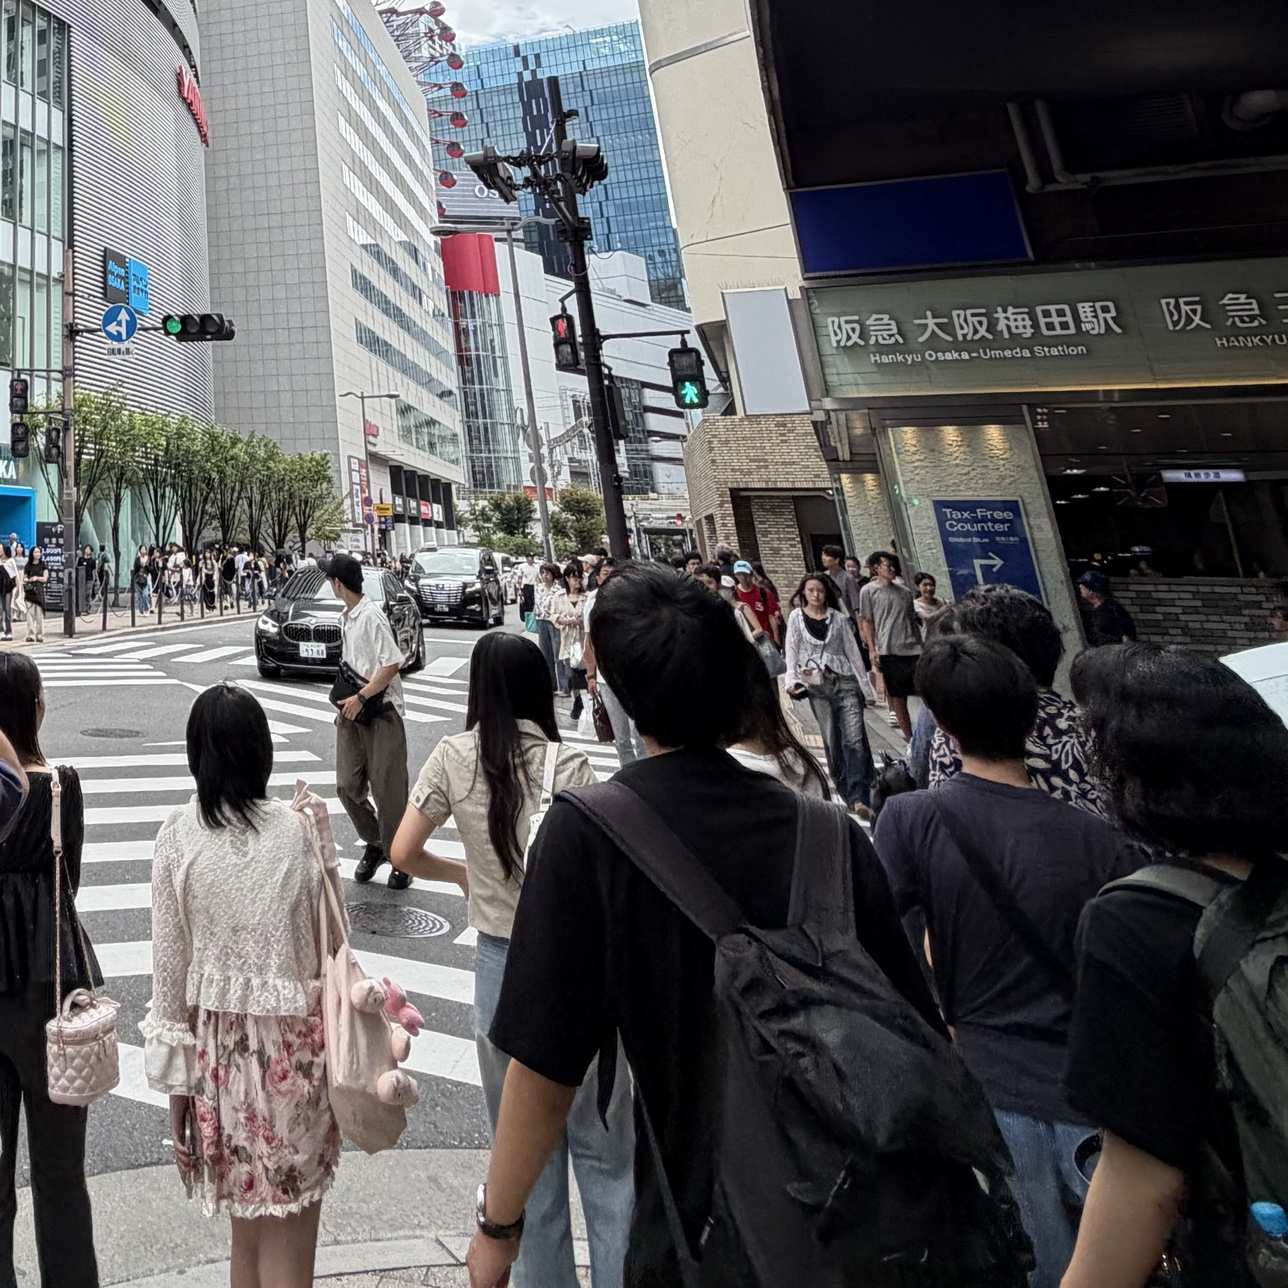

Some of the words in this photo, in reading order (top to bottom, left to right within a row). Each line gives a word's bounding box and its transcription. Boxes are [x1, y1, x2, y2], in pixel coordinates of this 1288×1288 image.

[108, 260, 125, 276] Alpen
[108, 274, 125, 291] OSAKA
[827, 314, 904, 348] 阪急
[913, 300, 1123, 344] 大阪梅田駅
[1215, 333, 1288, 348] HANKYU
[870, 350, 922, 364] Hankyu
[925, 345, 1031, 361] Osaka-Umeda
[1034, 343, 1088, 357] Station
[942, 508, 1014, 520] Tax-Free
[945, 520, 1011, 532] Counter
